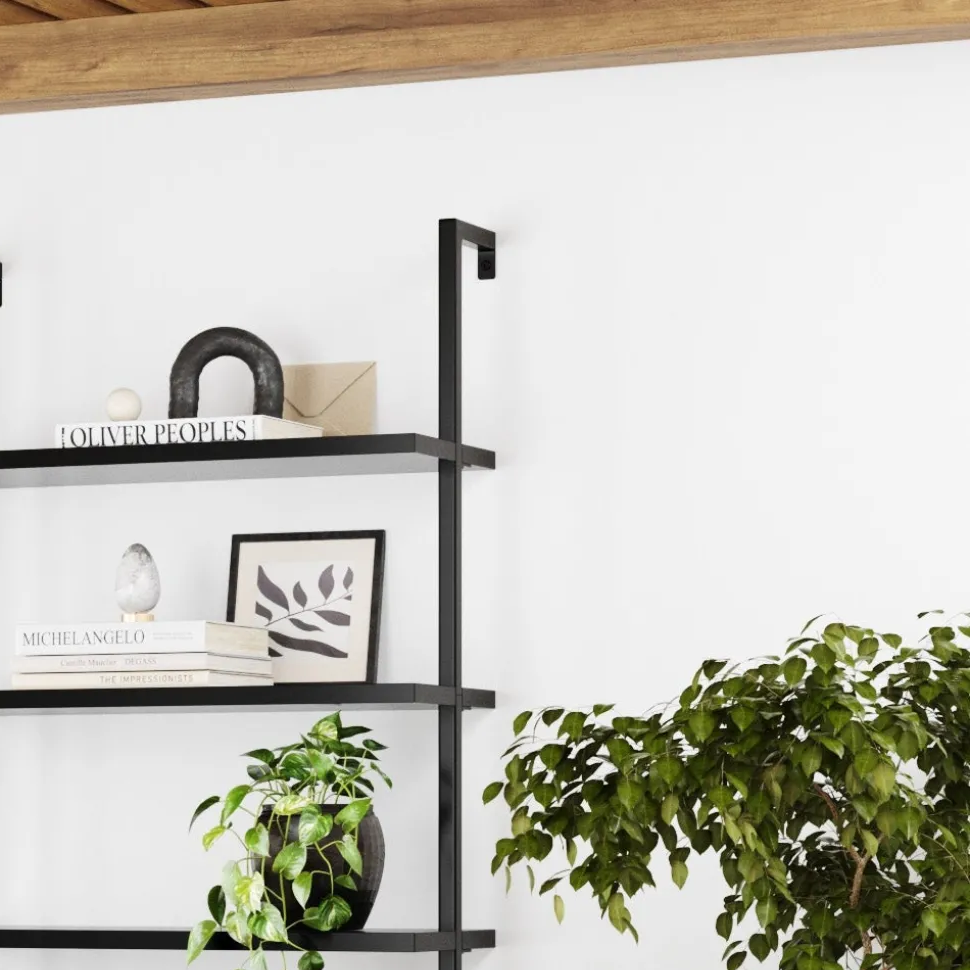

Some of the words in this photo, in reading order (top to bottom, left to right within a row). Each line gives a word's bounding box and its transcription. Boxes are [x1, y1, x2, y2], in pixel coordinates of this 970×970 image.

[70, 425, 148, 447] OLIVER
[155, 420, 247, 444] PEOPLES
[22, 629, 145, 646] MICHELANGELO
[99, 675, 117, 684] THE
[120, 674, 194, 684] IMPRESSIONISTS
